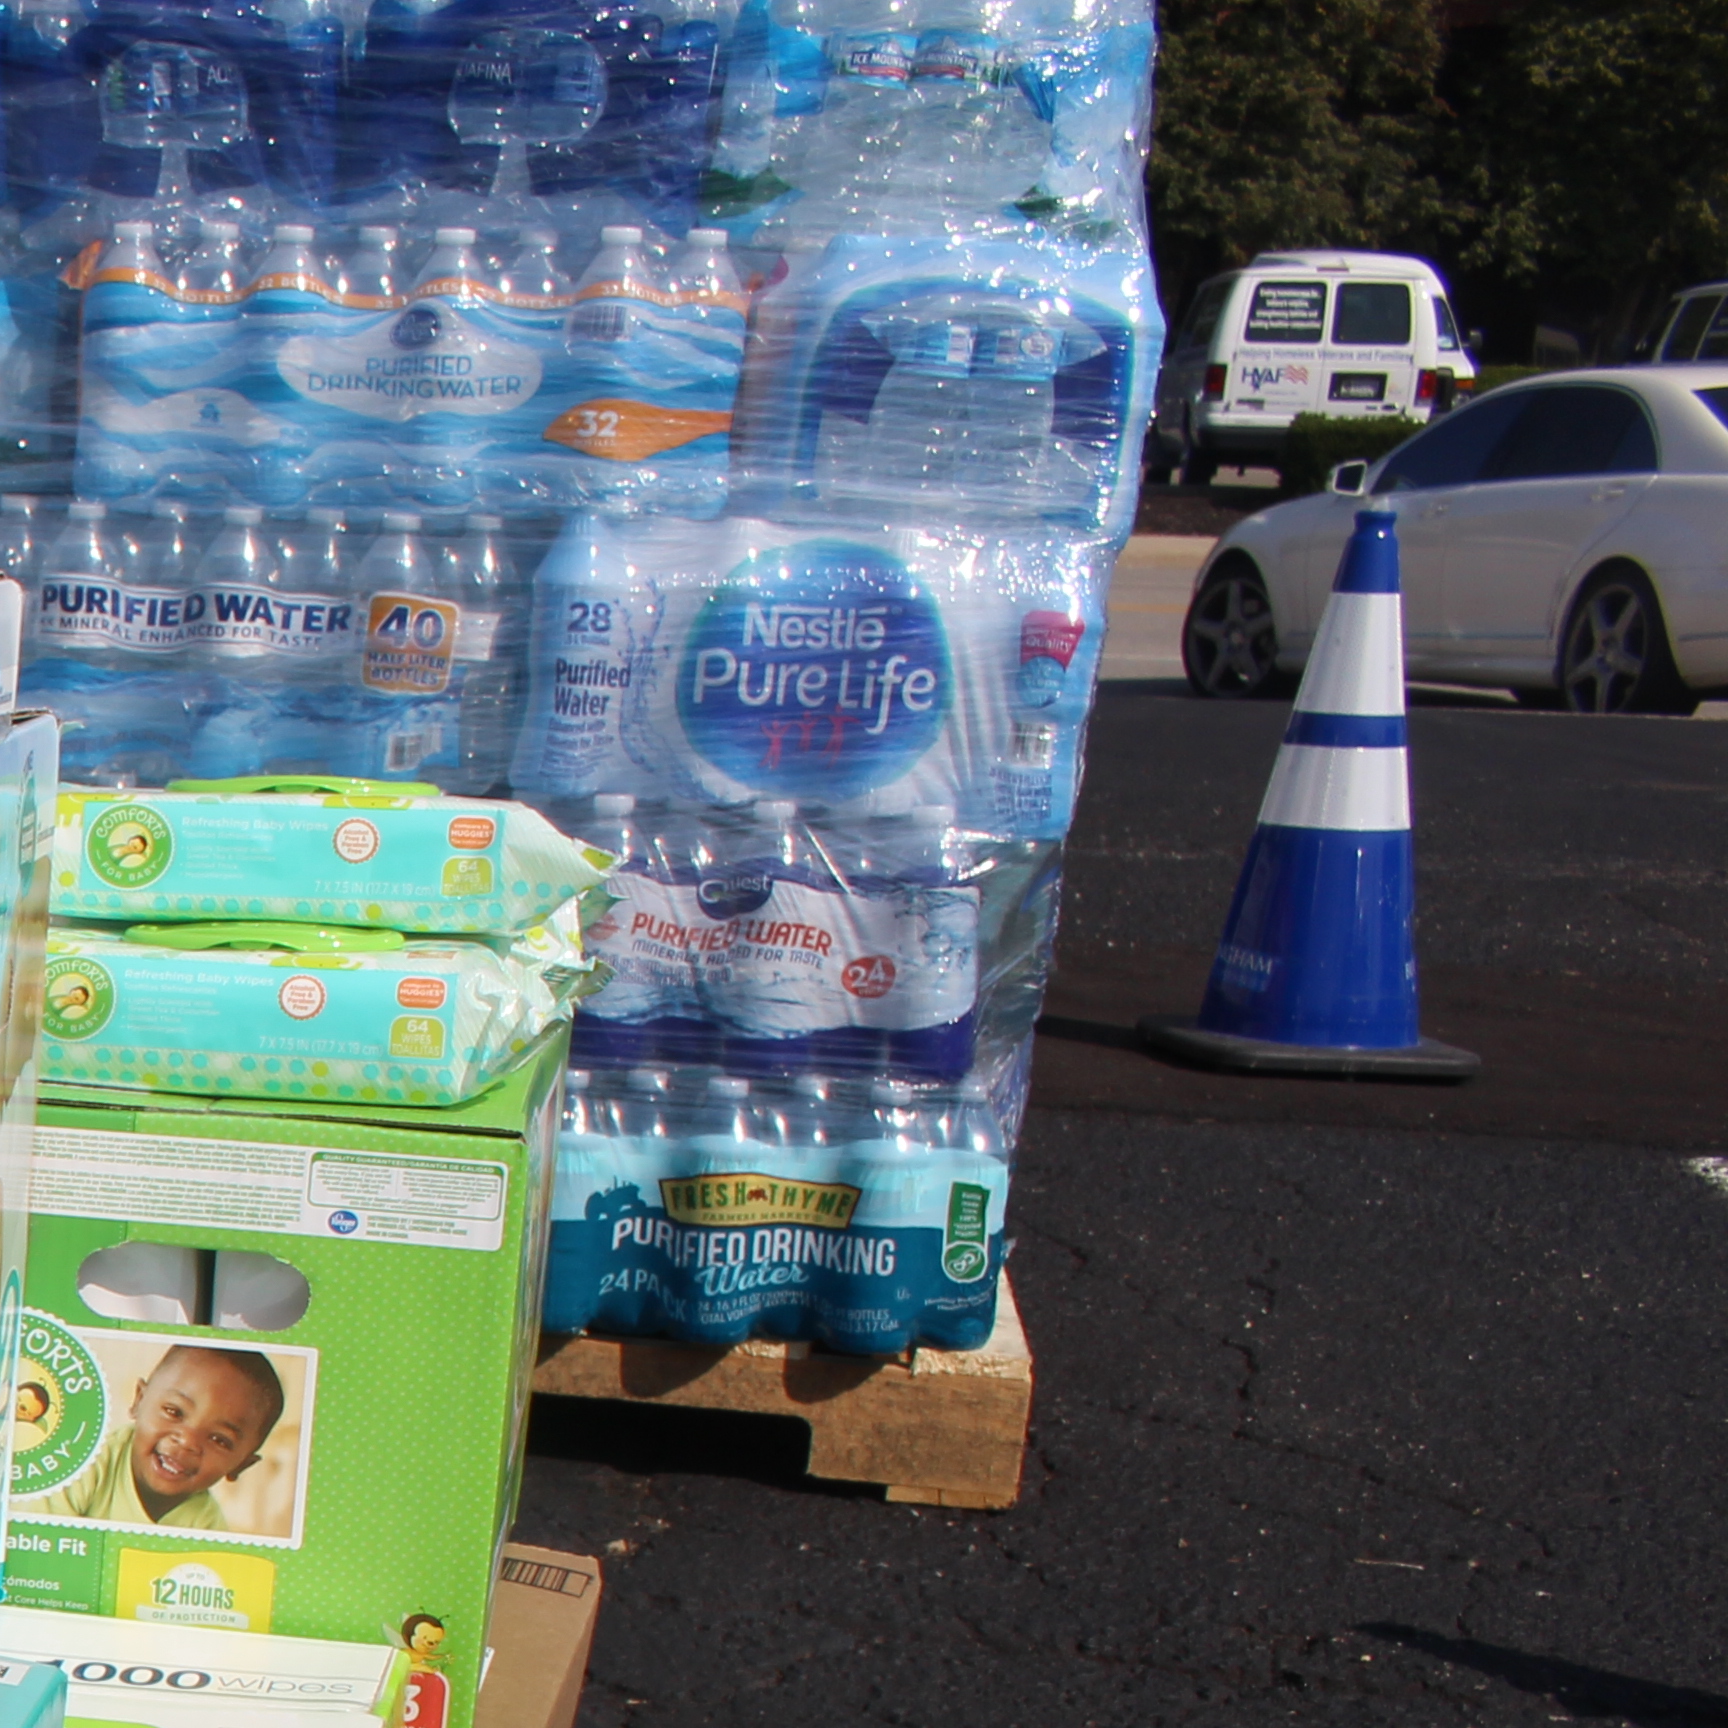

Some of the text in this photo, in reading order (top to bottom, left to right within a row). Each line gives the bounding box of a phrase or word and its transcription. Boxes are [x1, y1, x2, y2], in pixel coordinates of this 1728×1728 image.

[365, 354, 473, 378] PURIFIED
[437, 374, 524, 399] WATER
[576, 411, 619, 437] 32
[42, 583, 352, 634] PURIFIED WATER
[567, 603, 612, 634] 28
[139, 624, 226, 645] ENHANCED
[232, 626, 262, 640] FOR
[377, 605, 443, 650] 40
[743, 602, 889, 650] Nestlé
[554, 658, 632, 690] Purified
[553, 688, 611, 718] Water
[692, 648, 937, 735] Pure Life
[630, 912, 833, 957] PURIFIED WATER
[847, 958, 886, 989] 24
[671, 1180, 851, 1218] FRESH THYME
[611, 1217, 896, 1277] PURIFIED DRINKING
[695, 1263, 810, 1297] Water
[151, 1576, 235, 1609] 12 HOURS
[169, 1612, 236, 1626] PROTECTION
